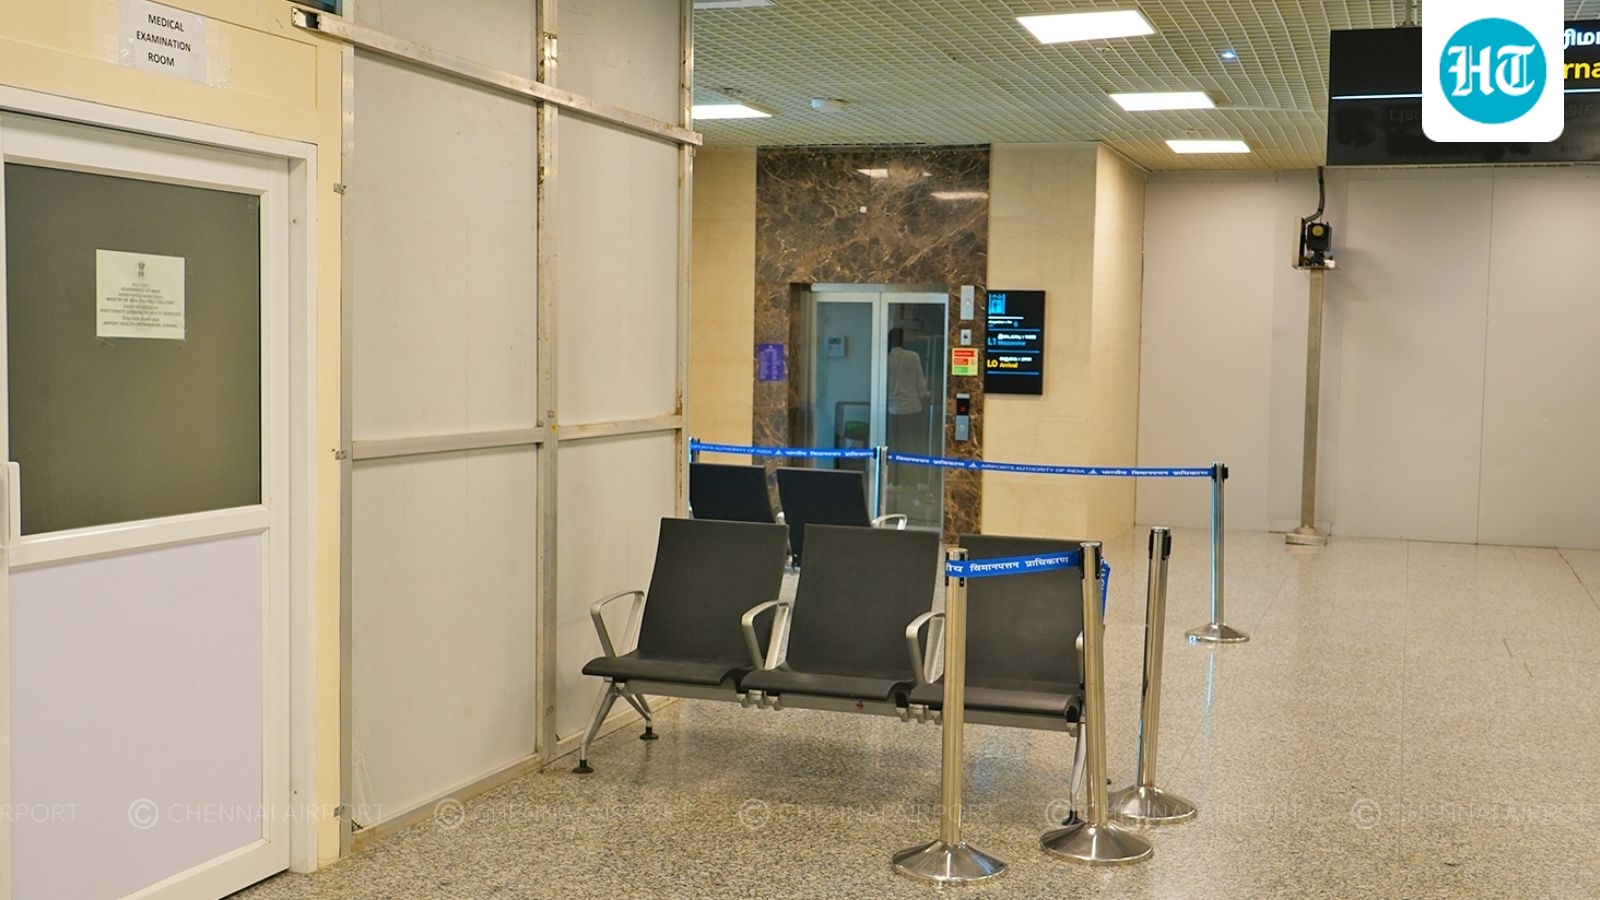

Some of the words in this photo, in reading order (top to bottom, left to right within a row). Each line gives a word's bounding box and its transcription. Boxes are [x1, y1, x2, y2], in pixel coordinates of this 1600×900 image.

[148, 14, 184, 32] MEDICAL
[136, 30, 191, 51] EXAMINATION
[148, 52, 175, 67] ROOM
[969, 561, 1019, 572] विमानपत्तन
[1025, 556, 1069, 568] प्राधिकरण
